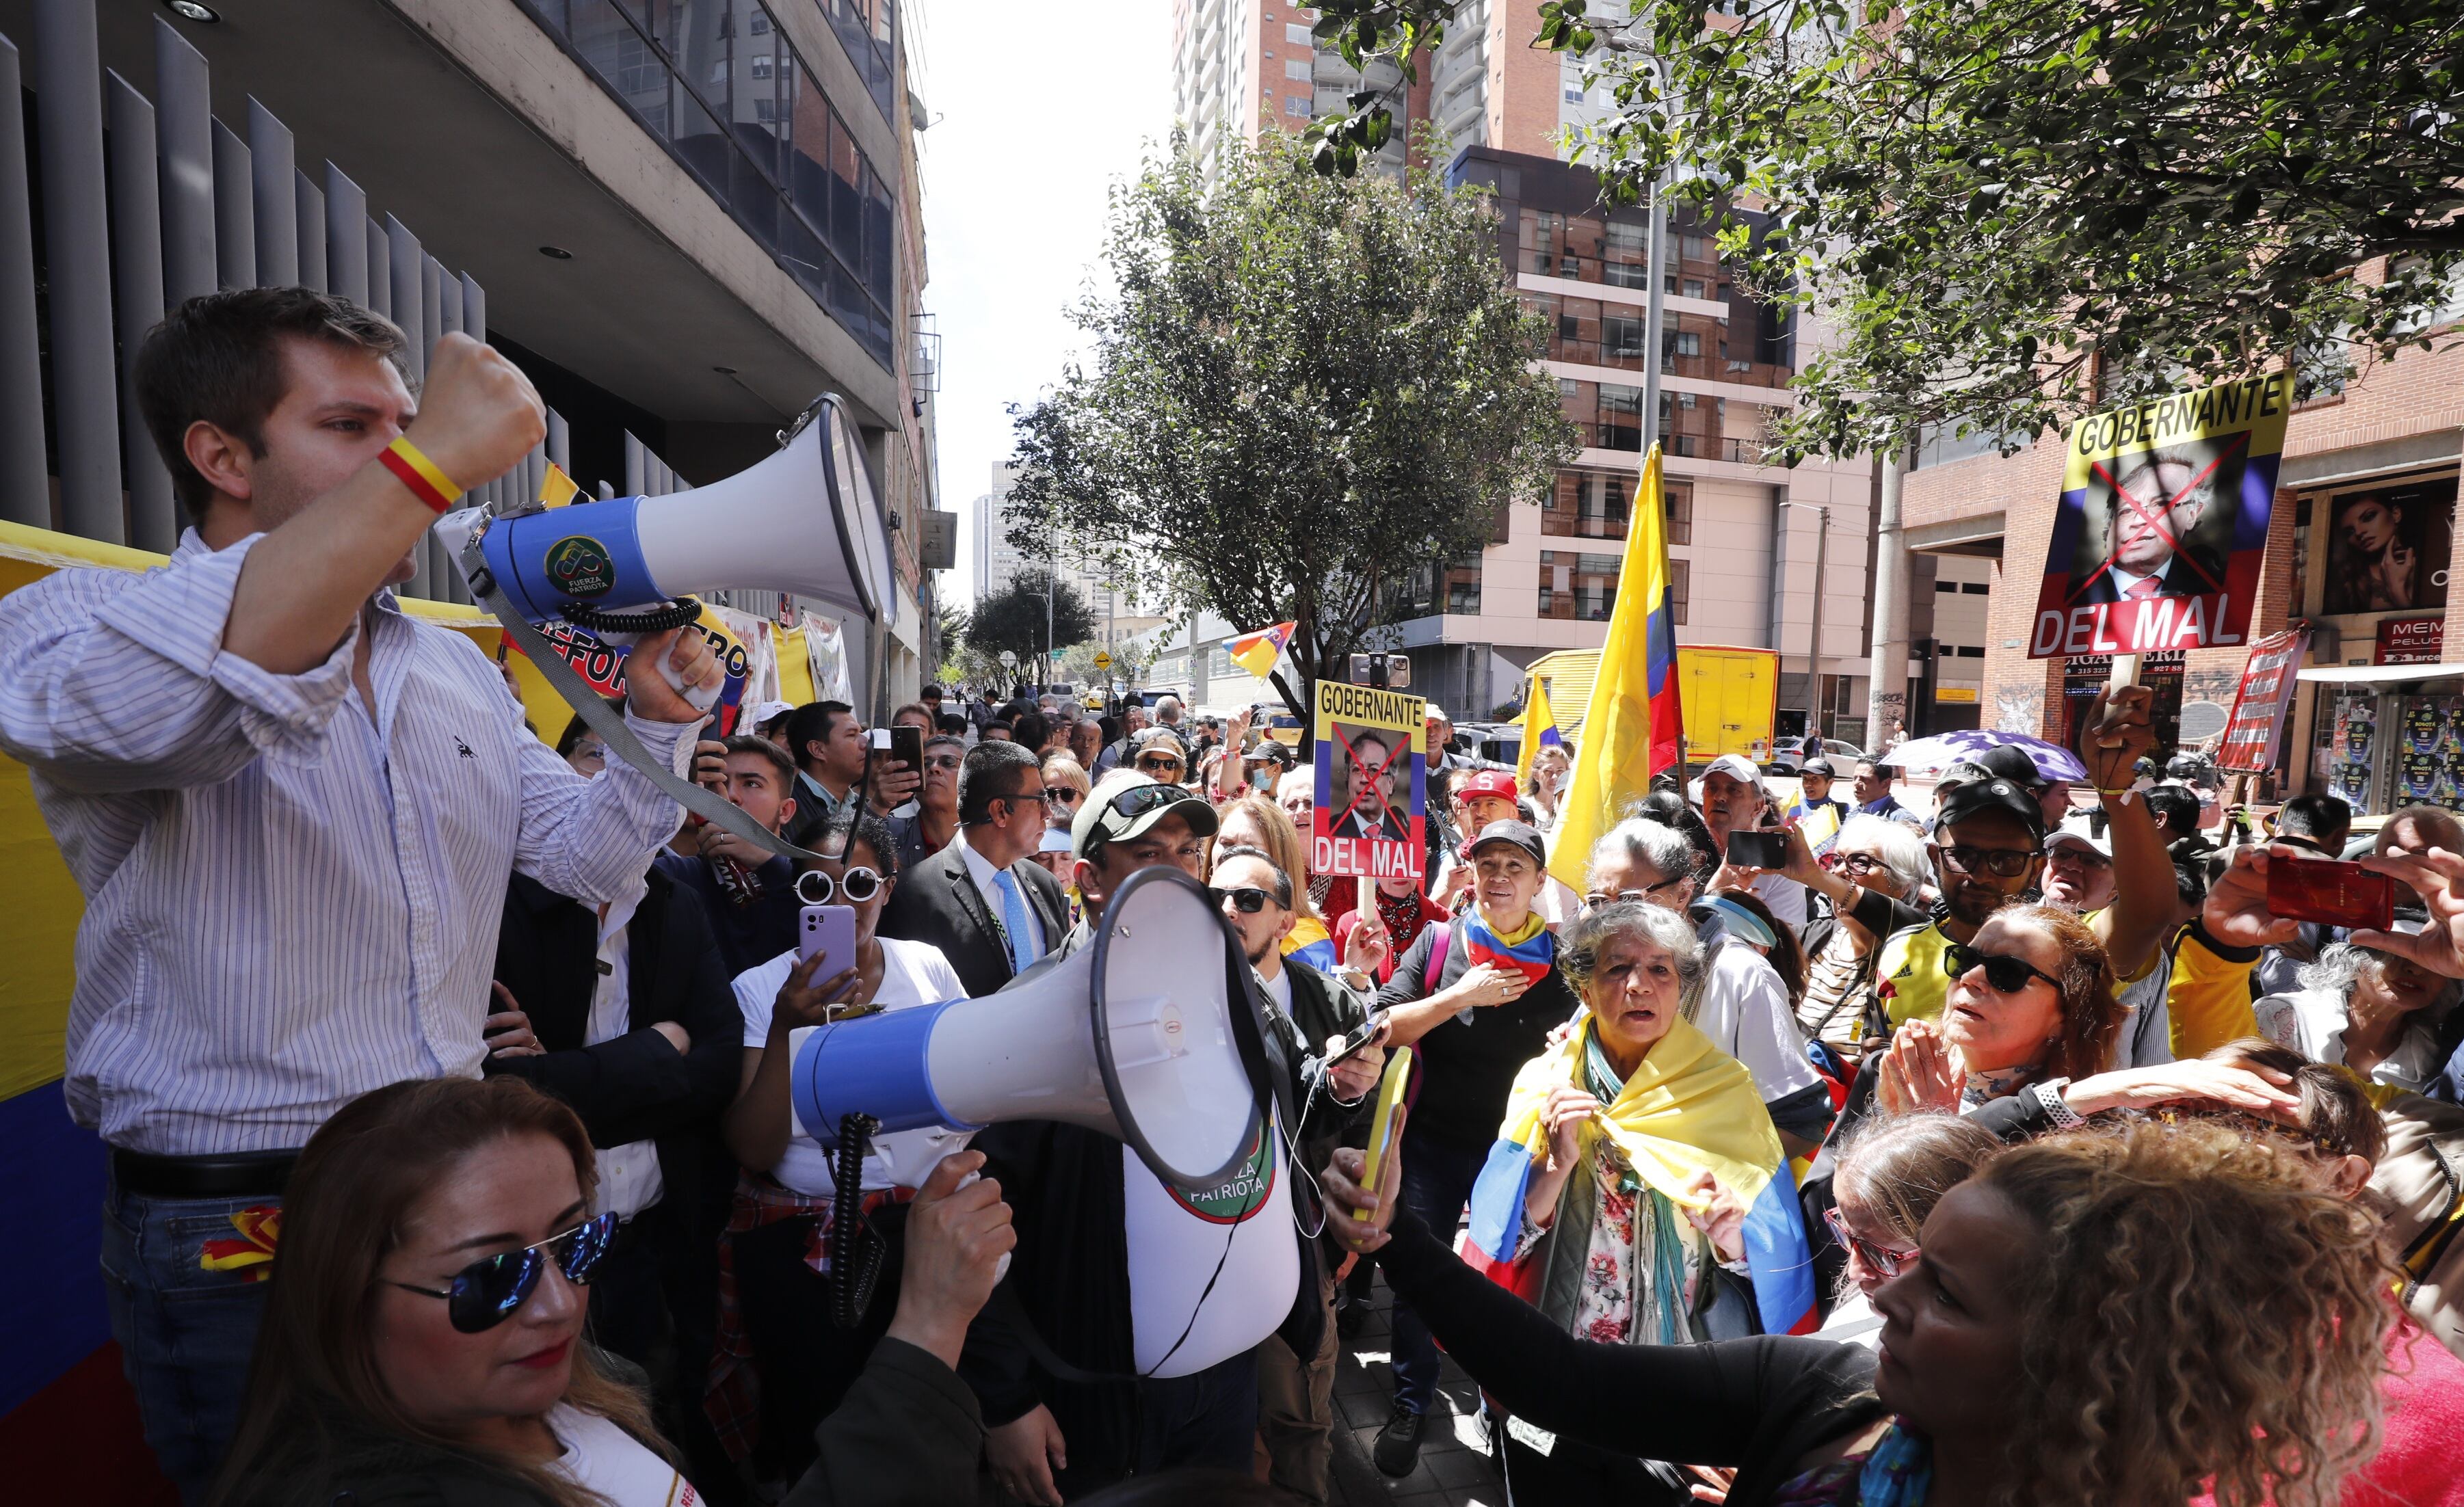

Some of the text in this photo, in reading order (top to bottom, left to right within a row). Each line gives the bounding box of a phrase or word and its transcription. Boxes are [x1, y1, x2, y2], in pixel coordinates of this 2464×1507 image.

[2078, 374, 2285, 457] GOBERNANTE
[569, 576, 602, 587] FUERZA
[569, 582, 608, 594] PATRIOTA
[2035, 594, 2240, 655] DEL MAL
[1321, 684, 1422, 726] GOBERNANTE
[1477, 773, 1494, 790] S
[1315, 837, 1421, 876] DEL MAL
[1190, 1177, 1264, 1202] PATRIOTA
